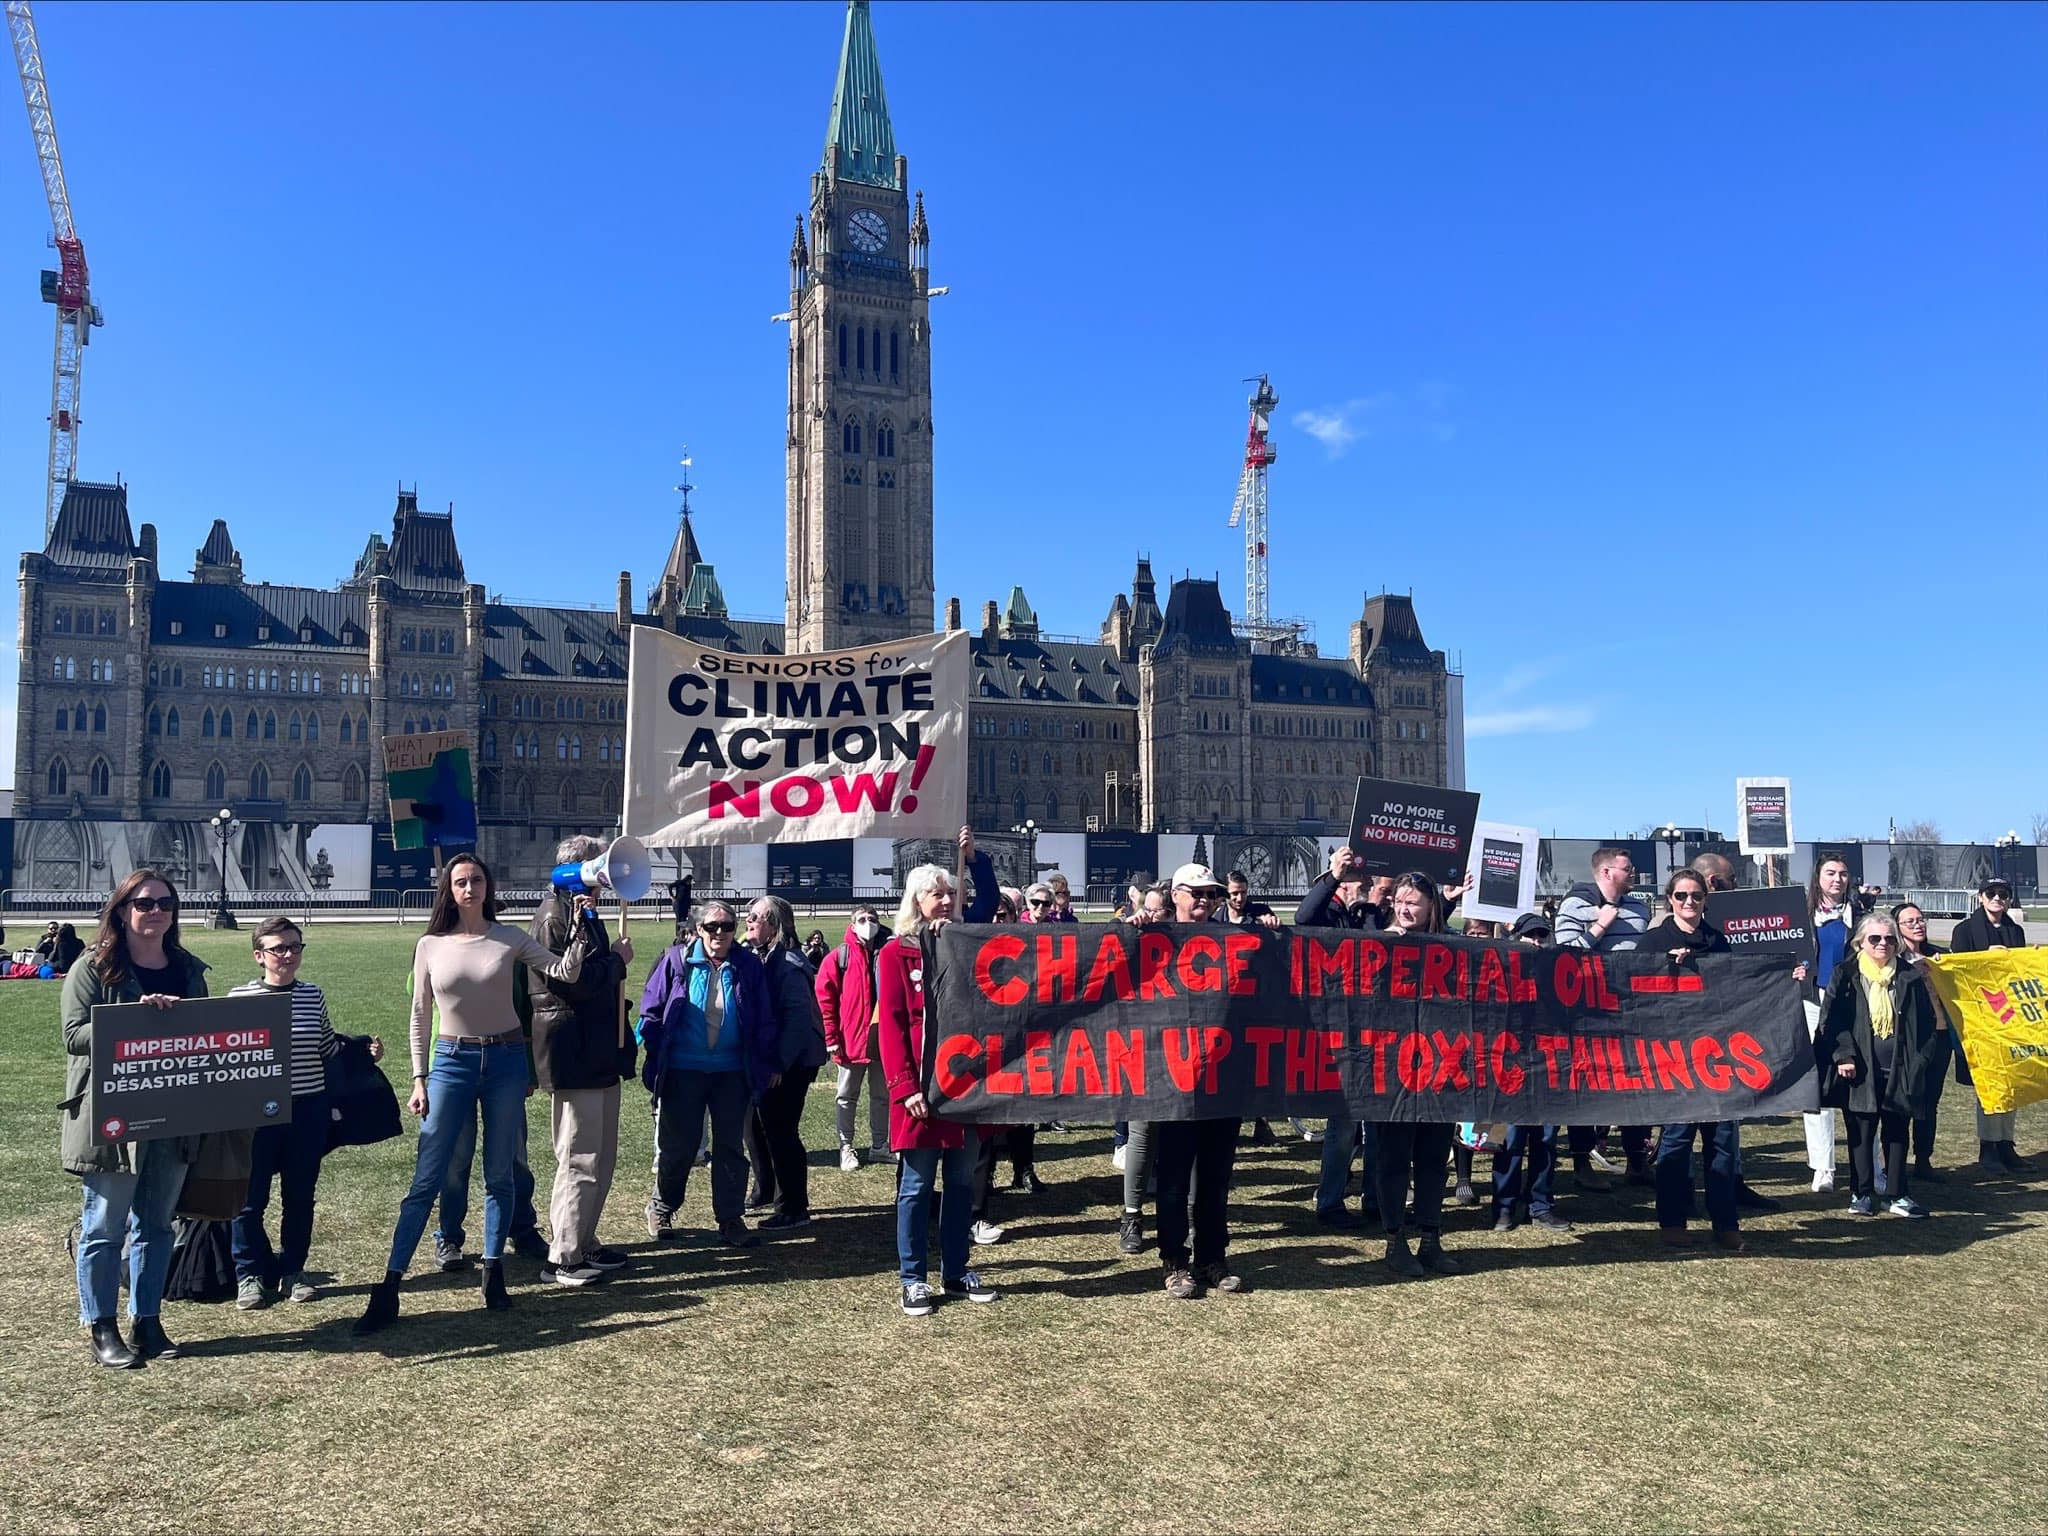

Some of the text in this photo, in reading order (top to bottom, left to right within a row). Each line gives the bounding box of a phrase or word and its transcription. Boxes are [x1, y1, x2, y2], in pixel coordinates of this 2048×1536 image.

[700, 651, 907, 678] SENIORS for
[667, 672, 934, 719] CLIMATE
[384, 735, 465, 753] WHAT THE
[678, 722, 922, 771] ACTION
[708, 745, 936, 819] NOW!
[1384, 802, 1445, 820] NO MORE
[1370, 814, 1456, 835] TOXIC SPILLS
[1365, 828, 1456, 849] NO MORE LIES
[1727, 916, 1784, 931] CLEAN UP
[1751, 928, 1805, 943] TAILINGS
[975, 932, 1620, 1011] CHARGE IMPERIAL OIL
[2021, 1001, 2043, 1022] OF
[124, 1032, 265, 1056] IMPERIAL OIL:
[112, 1049, 275, 1076] NETTOYEZ VOTRE
[935, 1026, 1772, 1100] CLEAN UP THE TOXIC TAILINGS
[103, 1064, 283, 1094] DÉSASTRE TOXIQUE
